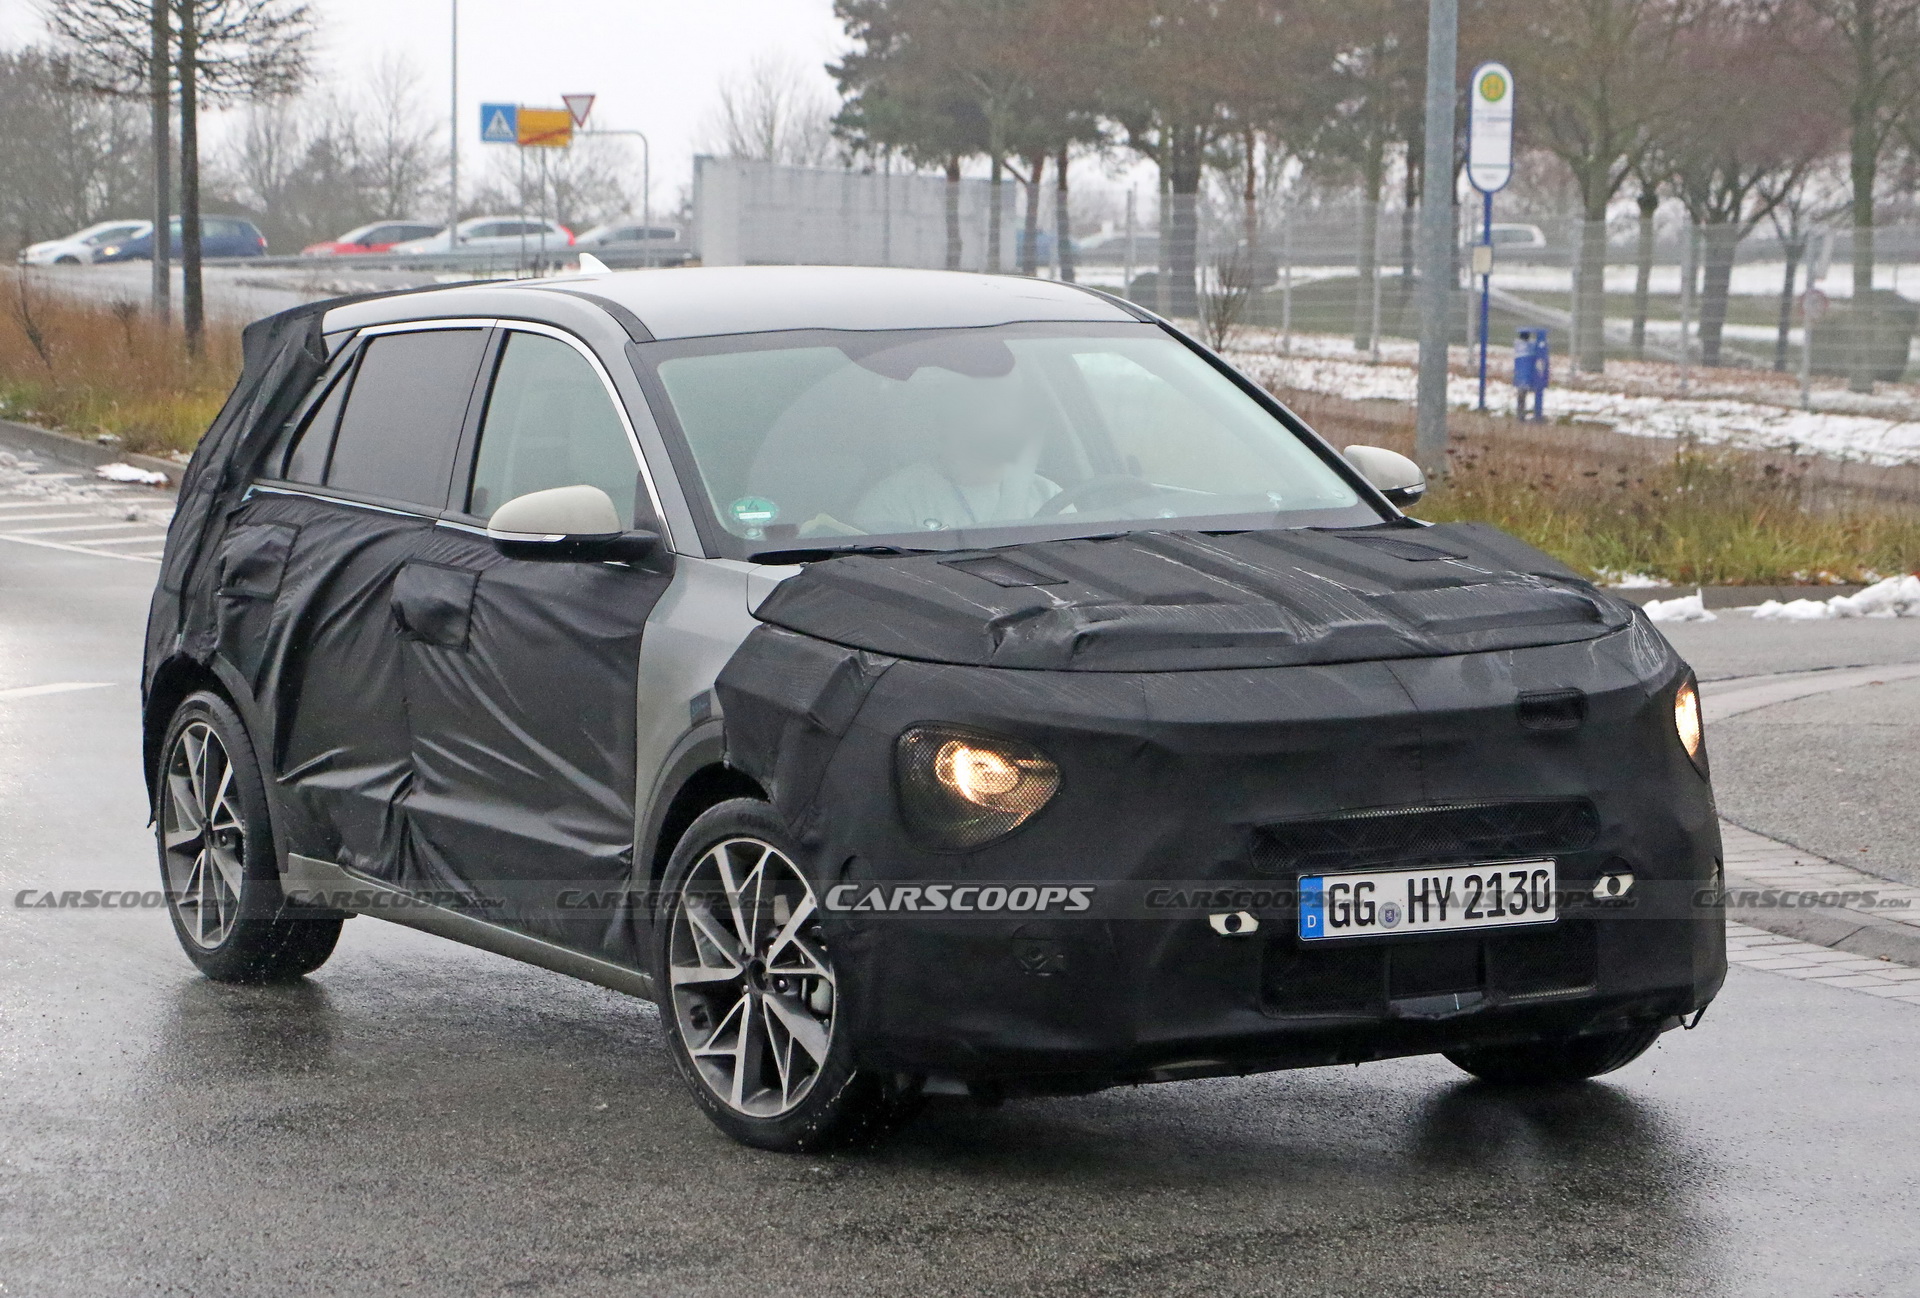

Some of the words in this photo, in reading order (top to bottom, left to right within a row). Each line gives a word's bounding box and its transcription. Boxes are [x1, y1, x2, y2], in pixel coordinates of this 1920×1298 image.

[1328, 881, 1376, 928] GG
[1407, 875, 1453, 924] HY
[1463, 869, 1551, 920] 2130
[1307, 915, 1317, 928] D
